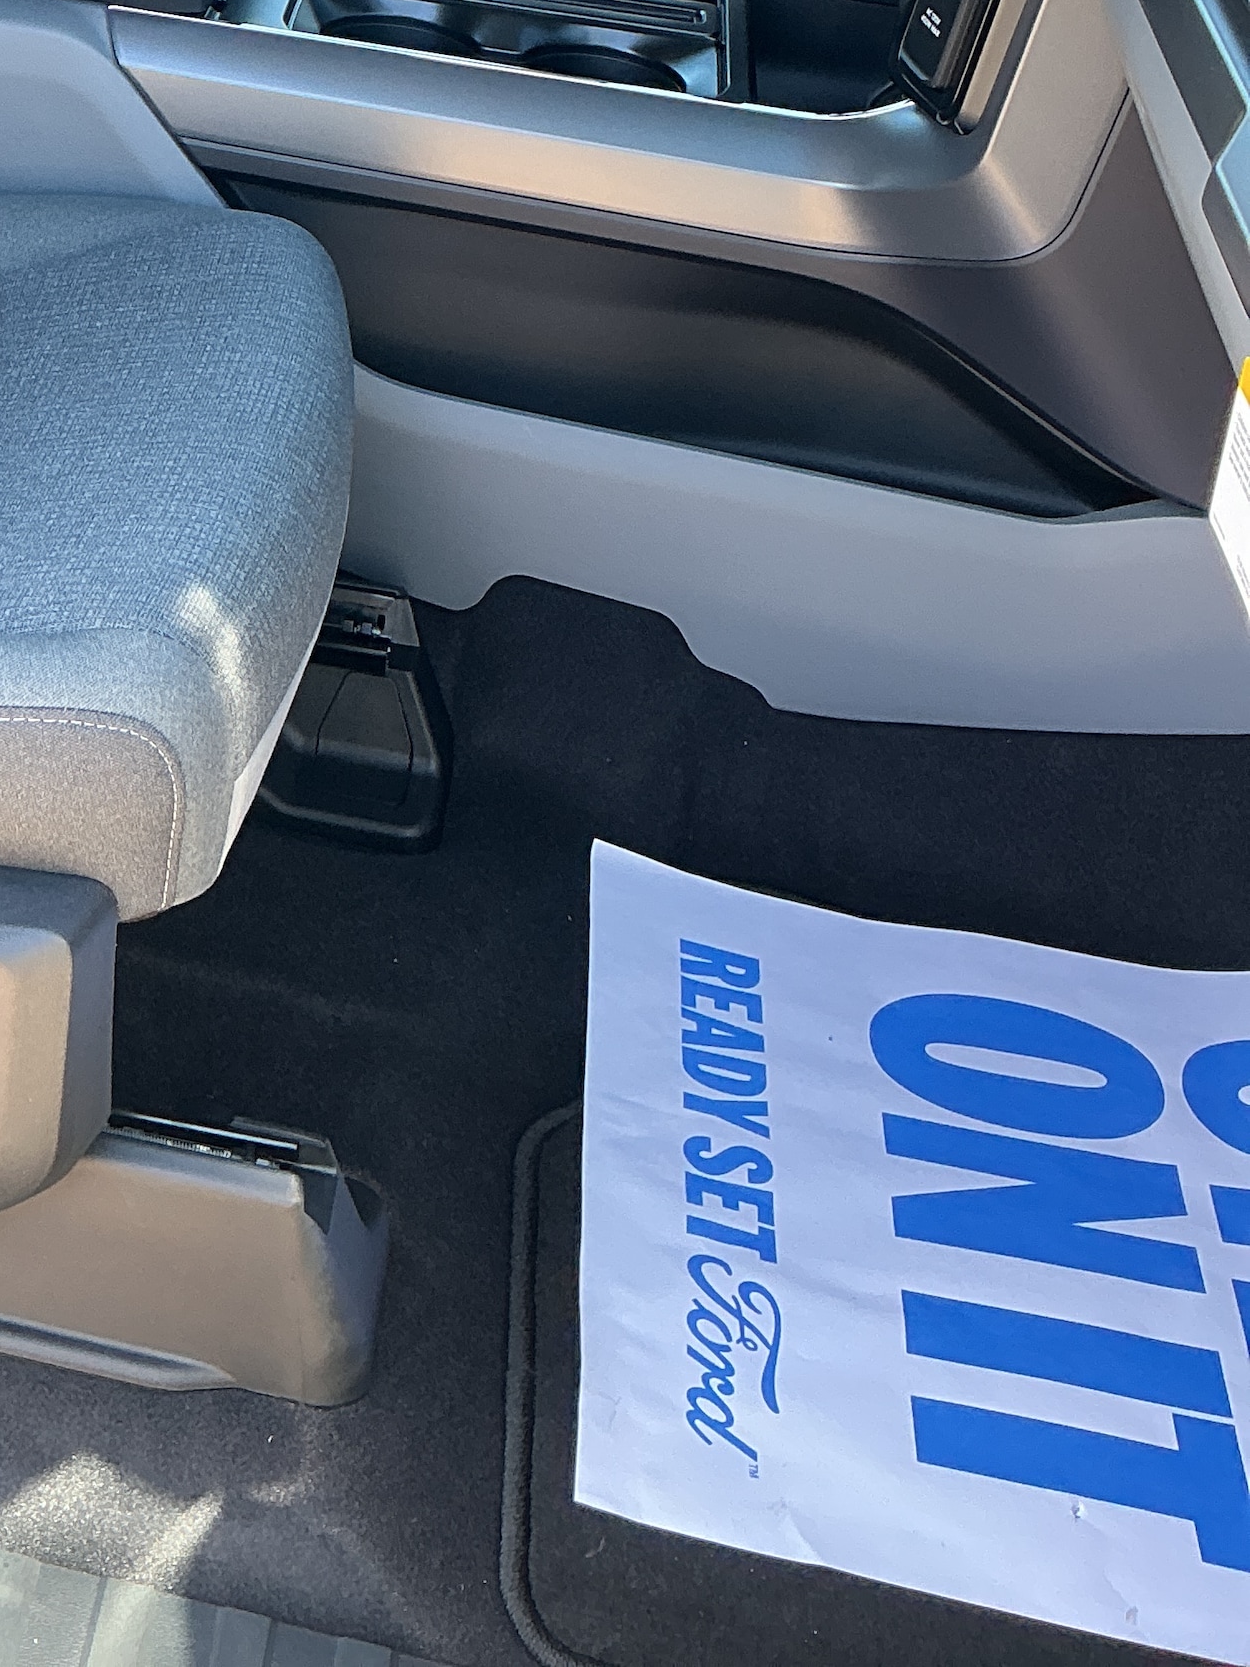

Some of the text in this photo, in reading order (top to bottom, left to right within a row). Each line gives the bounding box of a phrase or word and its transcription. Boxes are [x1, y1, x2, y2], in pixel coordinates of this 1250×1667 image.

[680, 938, 770, 1139] READY
[683, 1135, 778, 1264] SET
[869, 993, 1250, 1574] ON IT
[685, 1254, 781, 1463] Ford
